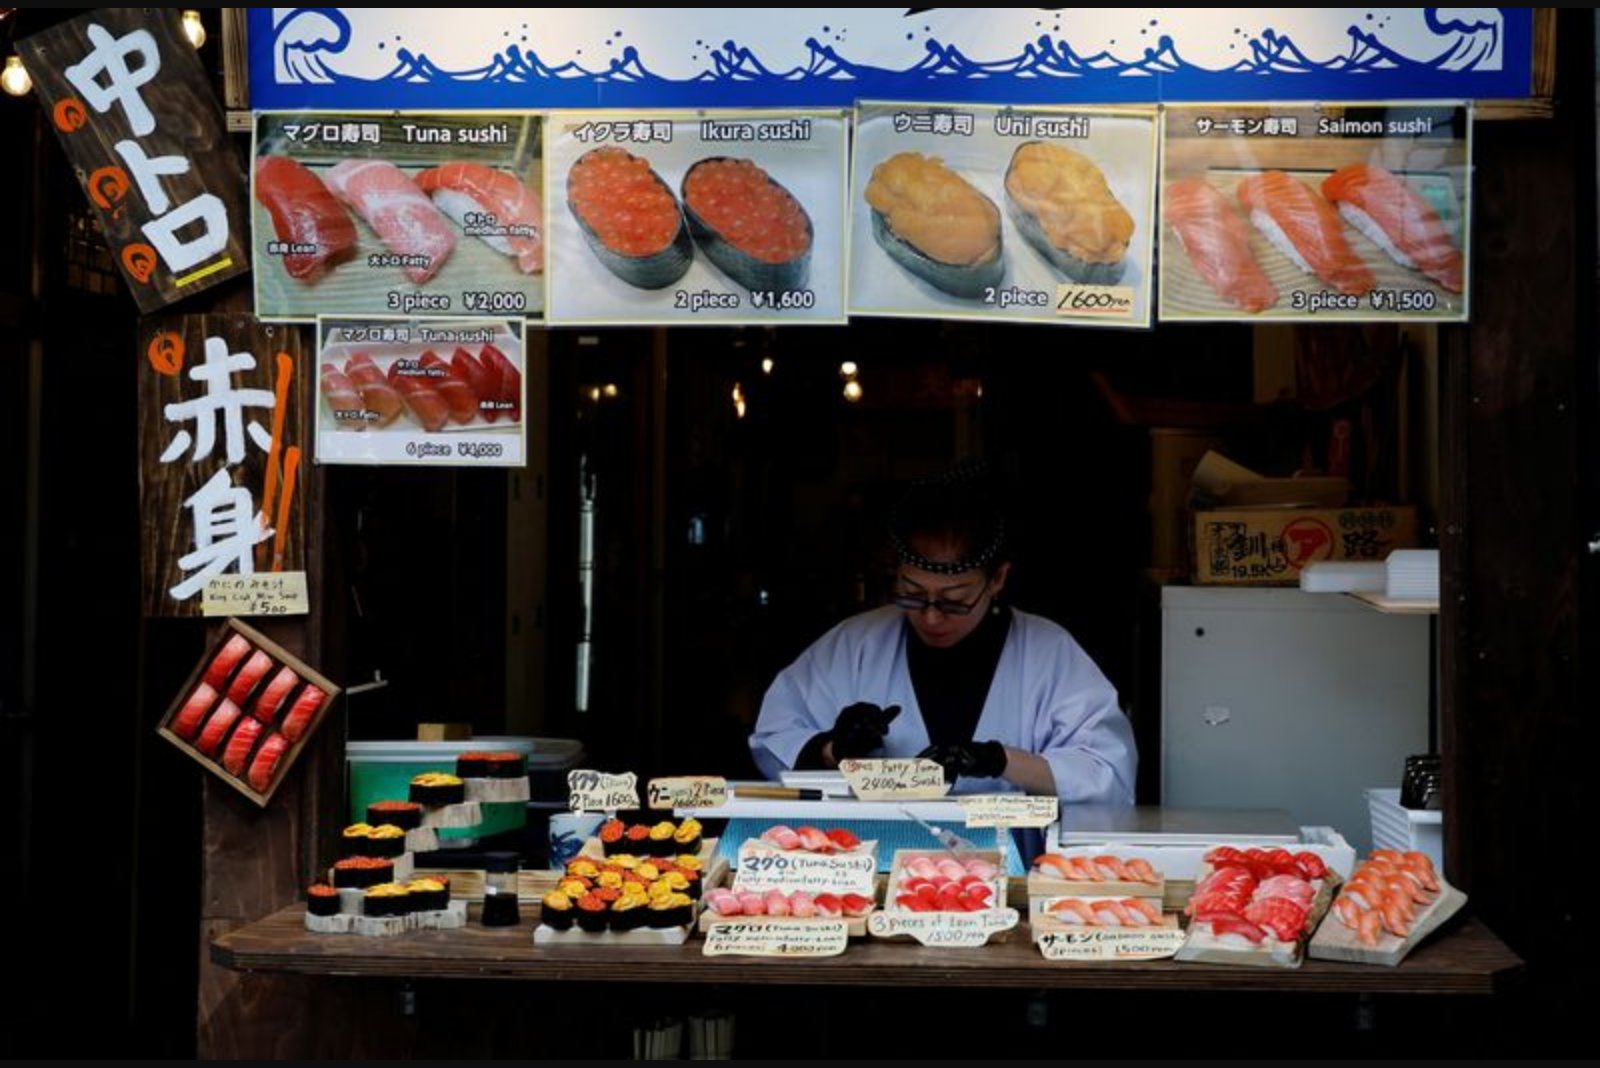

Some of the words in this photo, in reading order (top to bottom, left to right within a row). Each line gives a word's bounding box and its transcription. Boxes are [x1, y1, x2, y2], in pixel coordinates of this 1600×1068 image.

[283, 123, 380, 143] マグロ寿司
[402, 124, 450, 143] Tuna
[457, 123, 508, 143] sushi
[574, 121, 672, 142] イクラ寿司
[701, 119, 753, 141] Ikura
[757, 119, 810, 141] sushi
[894, 112, 974, 135] ウニ寿司
[995, 115, 1031, 136] Uni
[1035, 117, 1089, 138] sushi
[1196, 117, 1298, 136] サーモン寿司
[1318, 117, 1384, 134] Salmon
[1387, 117, 1433, 134] sushi
[64, 22, 230, 274] 中トロ
[464, 212, 497, 225] 中トロ
[464, 226, 508, 236] medium
[510, 225, 537, 238] fatty
[291, 243, 317, 255] Lean
[369, 255, 401, 268] 大トロ
[402, 255, 431, 269] Fatty
[387, 291, 400, 309] 3
[403, 292, 450, 312] piece
[463, 291, 527, 312] ¥2,000
[675, 290, 688, 308] 2
[692, 290, 739, 312] piece
[751, 290, 815, 310] ¥1,600
[984, 286, 996, 303] 2
[1000, 286, 1048, 308] piece
[1292, 290, 1306, 308] 3
[1309, 290, 1358, 312] piece
[1370, 290, 1435, 310] ¥1,500
[341, 327, 411, 342] マグロ寿司
[421, 329, 455, 342] Tuna
[456, 329, 495, 342] sushi
[406, 441, 417, 456] 6
[417, 442, 451, 458] piece
[458, 442, 503, 458] ¥4,000
[160, 335, 276, 601] 赤身
[571, 793, 581, 811] 2
[873, 915, 887, 933] 3
